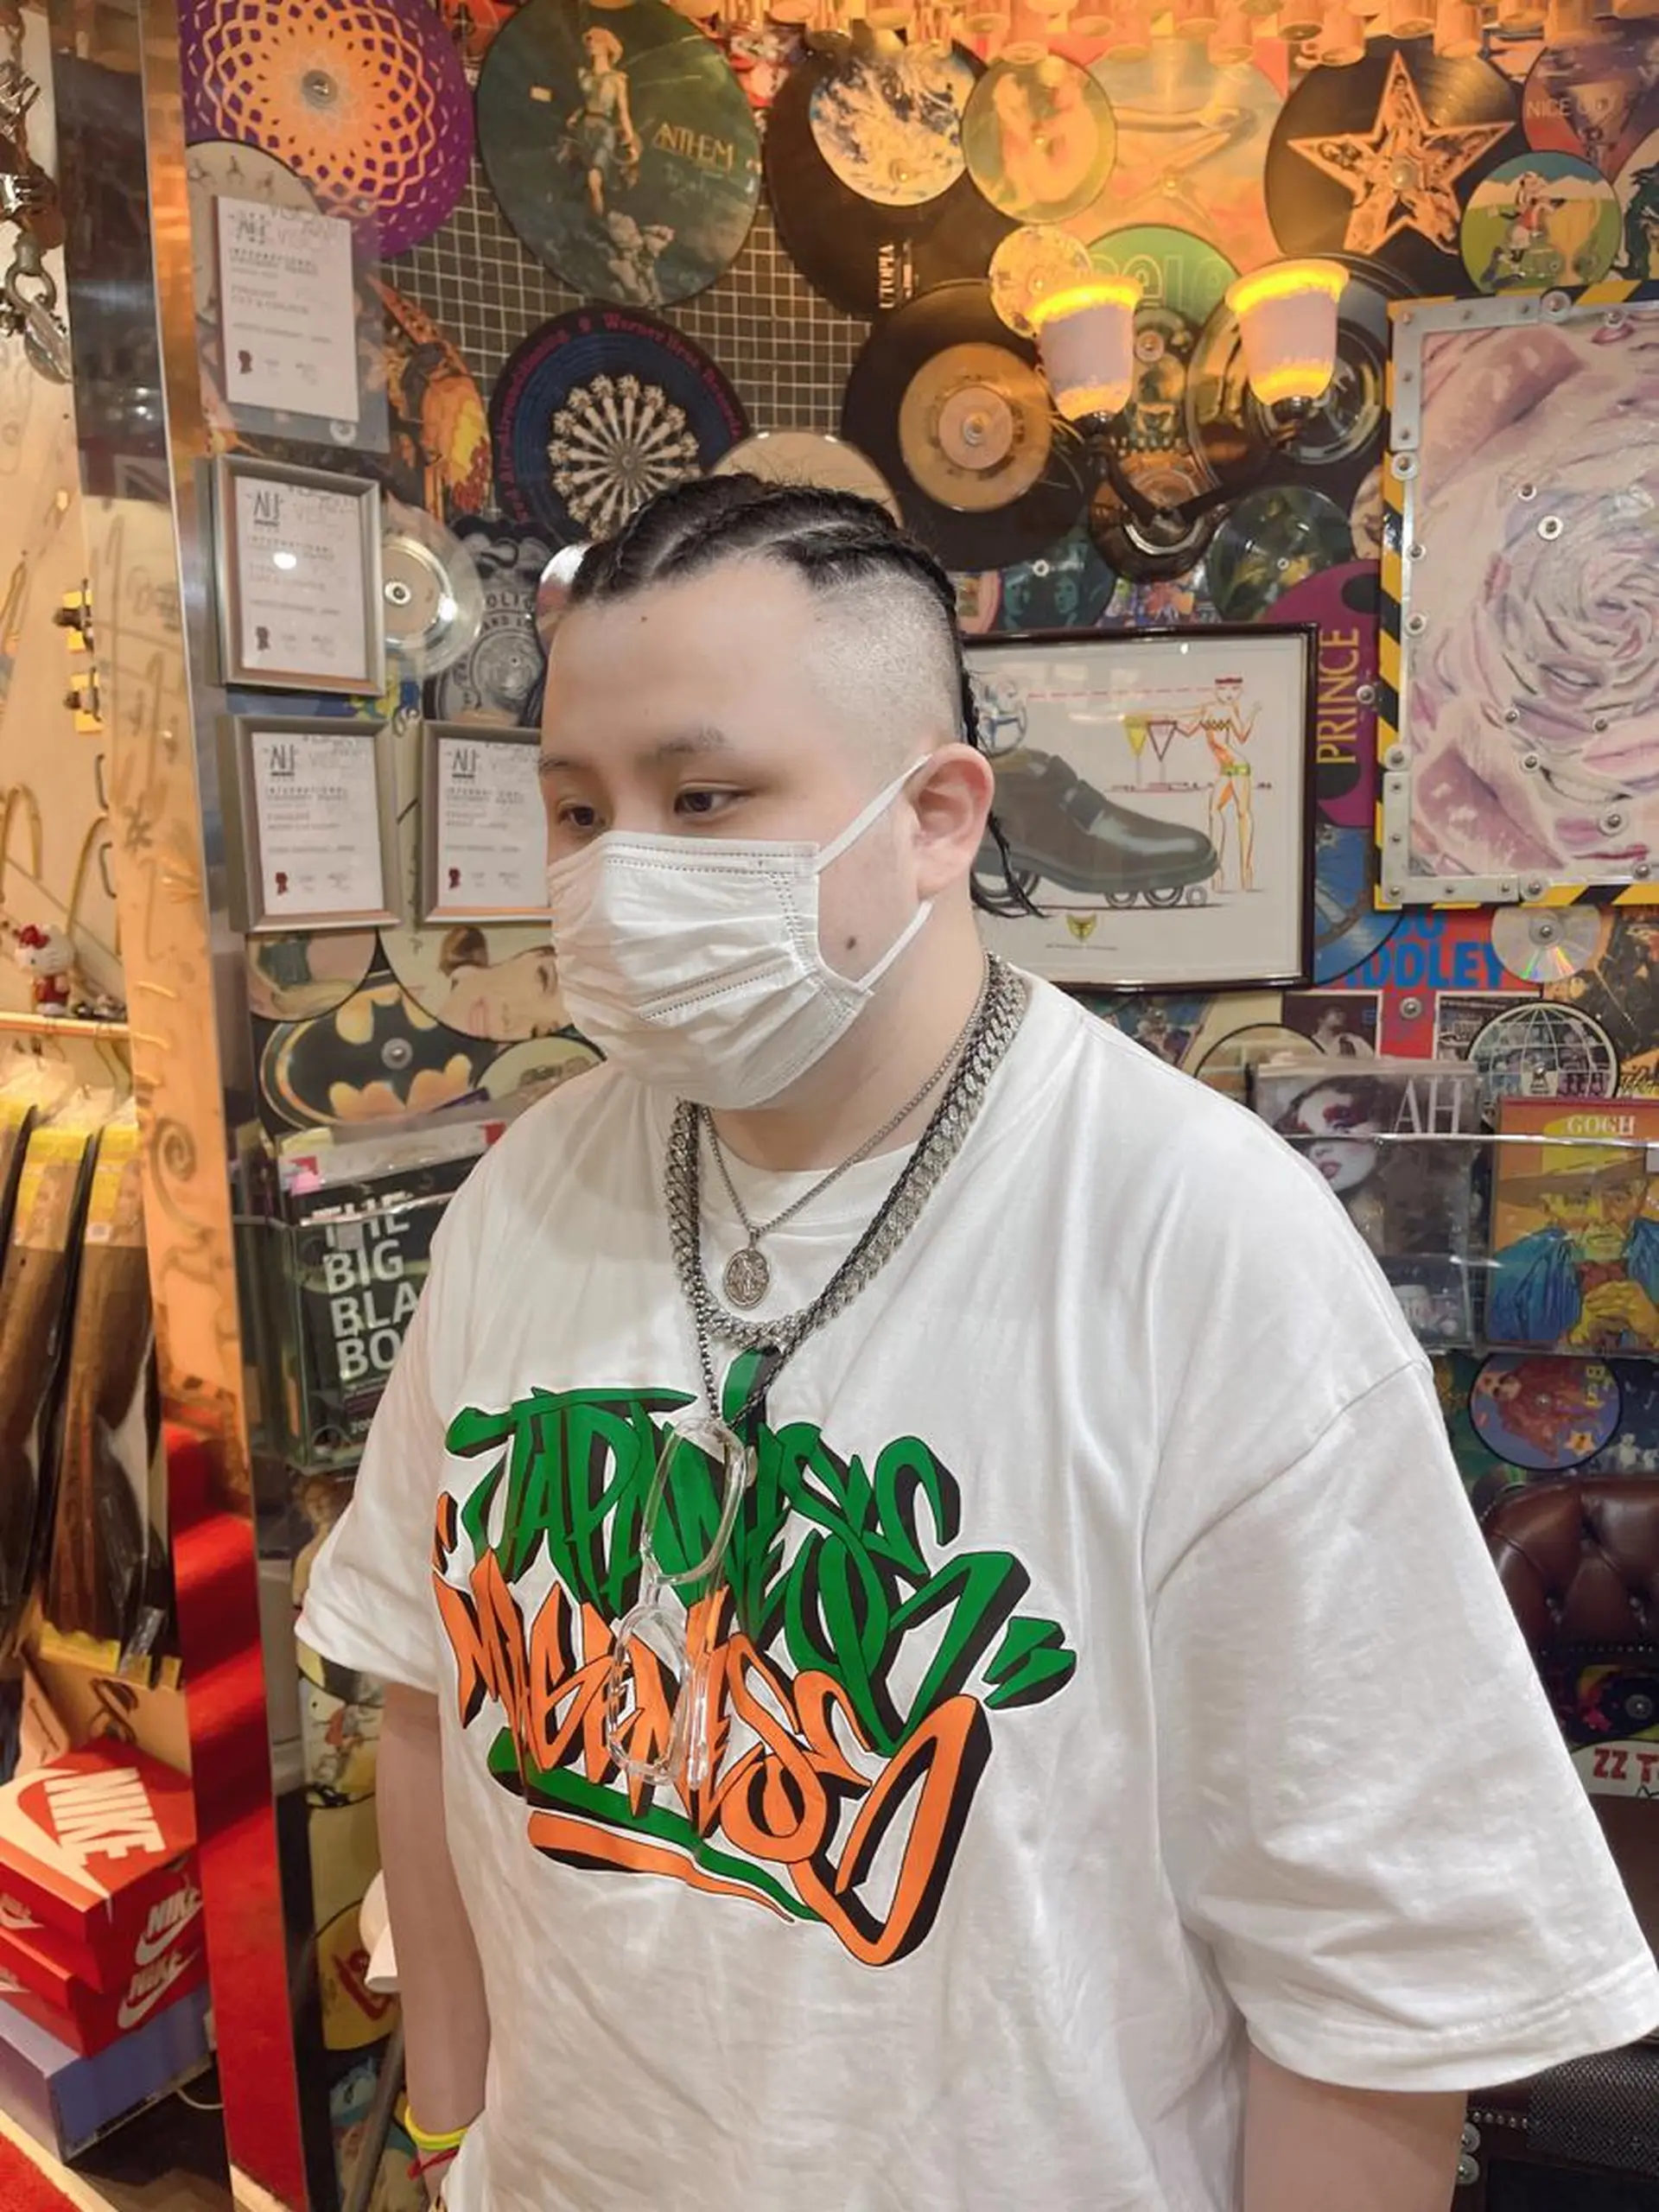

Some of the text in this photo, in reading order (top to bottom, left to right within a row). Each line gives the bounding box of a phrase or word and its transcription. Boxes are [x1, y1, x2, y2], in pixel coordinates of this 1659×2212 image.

[1316, 626, 1361, 764] PRINCE
[1344, 941, 1503, 989] DDLEY
[1566, 1114, 1637, 1136] GOGH
[311, 1190, 415, 1249] THE
[322, 1238, 405, 1295] BIG
[329, 1280, 421, 1339] BLA
[335, 1327, 404, 1382] BO
[1592, 1747, 1659, 1785] ZZ T
[44, 1767, 166, 1868] NIKE
[147, 1886, 200, 1939] NIKE
